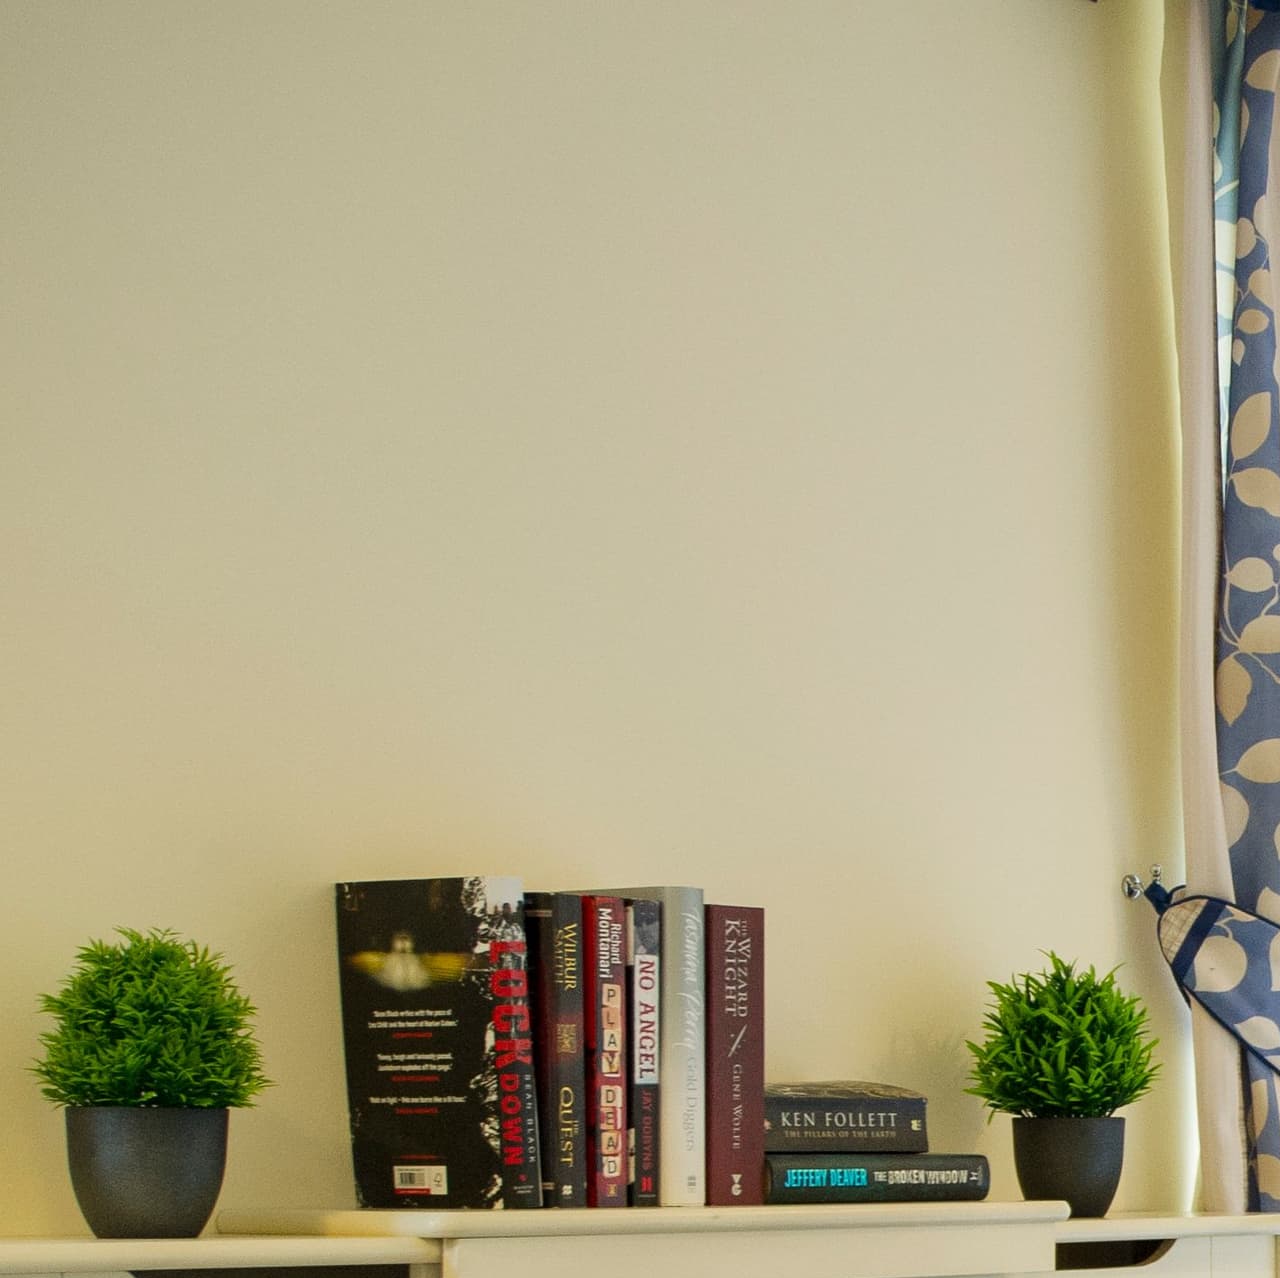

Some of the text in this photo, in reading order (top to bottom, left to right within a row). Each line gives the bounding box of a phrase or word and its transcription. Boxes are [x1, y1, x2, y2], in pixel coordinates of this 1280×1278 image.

[554, 929, 564, 984] SMITH
[563, 923, 577, 991] WILBUR
[598, 908, 613, 979] Montanari
[611, 923, 622, 965] Richard
[725, 919, 740, 1017] KNIGHT
[737, 938, 751, 1018] WIZARD
[640, 960, 656, 1079] NO ANGEL
[605, 988, 618, 1174] PLAY DEAD
[642, 1090, 654, 1112] JAY
[732, 1064, 744, 1150] GENE WOLFE
[526, 1119, 536, 1163] BLACK
[559, 1086, 574, 1168] QUEST
[682, 1097, 697, 1152] Diggers
[781, 1111, 898, 1128] KEN FOLLETT
[804, 1130, 836, 1139] PILLARS
[784, 1168, 868, 1188] JEFFERY DEAVER
[874, 1170, 968, 1184] THE BROKEN WINDOW
